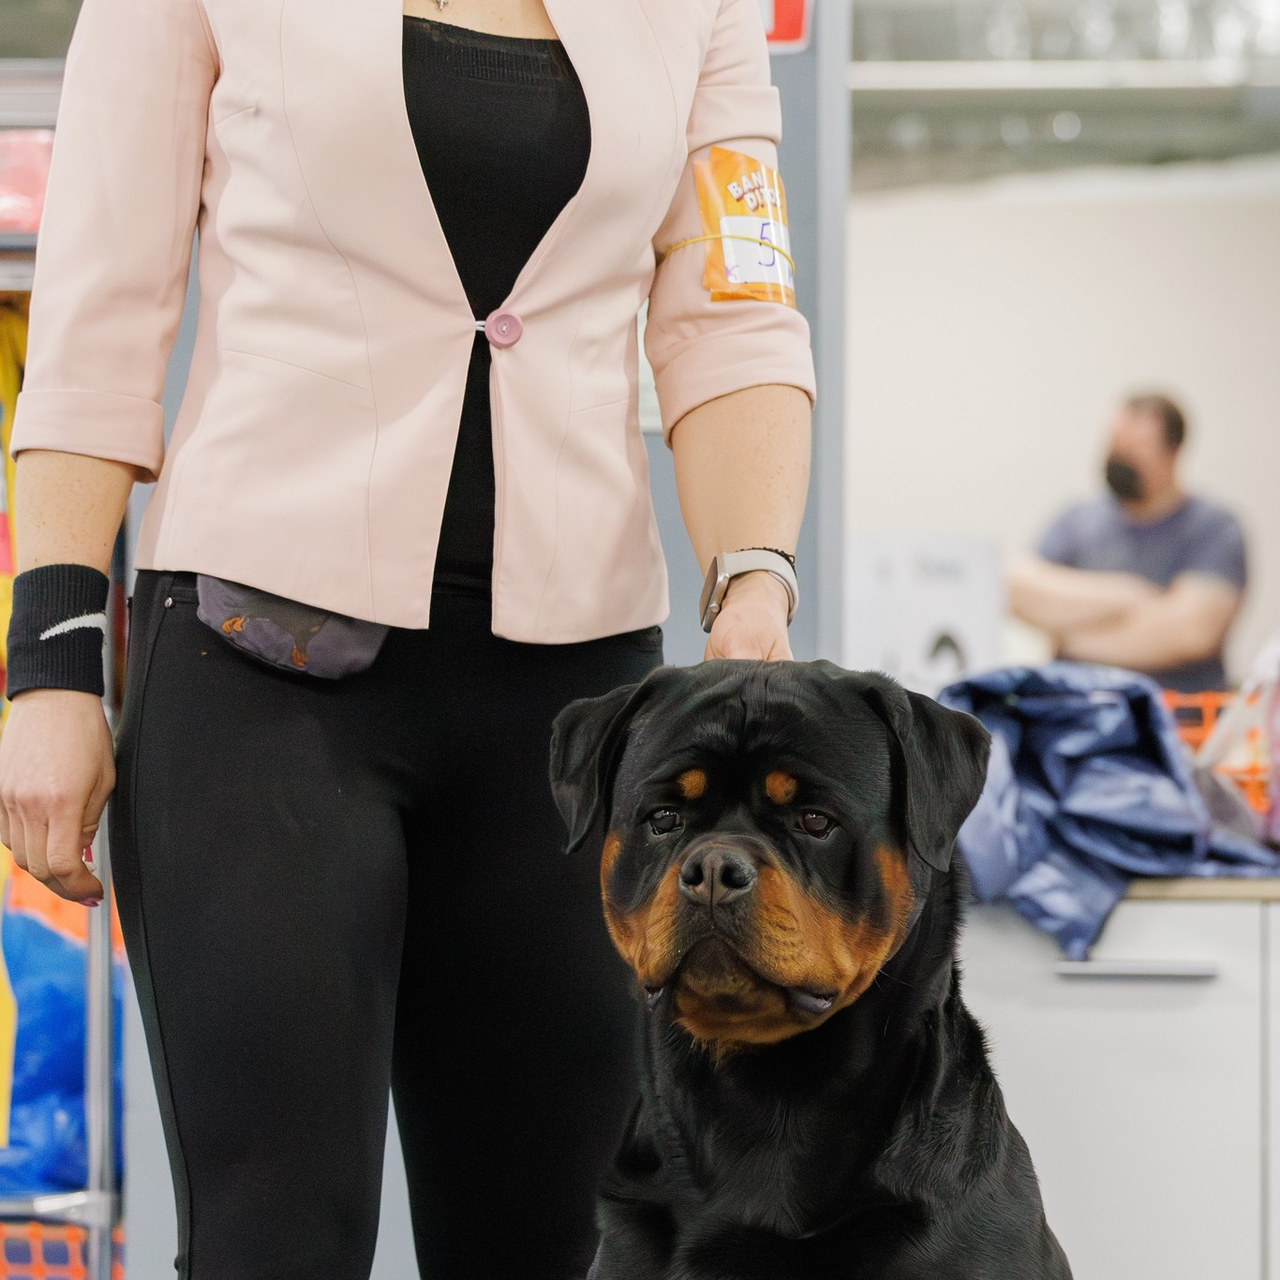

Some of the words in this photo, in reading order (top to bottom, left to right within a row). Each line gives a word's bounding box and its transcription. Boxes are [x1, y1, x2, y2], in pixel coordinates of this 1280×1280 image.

[727, 172, 764, 199] BAN
[744, 188, 781, 210] DITO
[758, 223, 775, 266] 5
